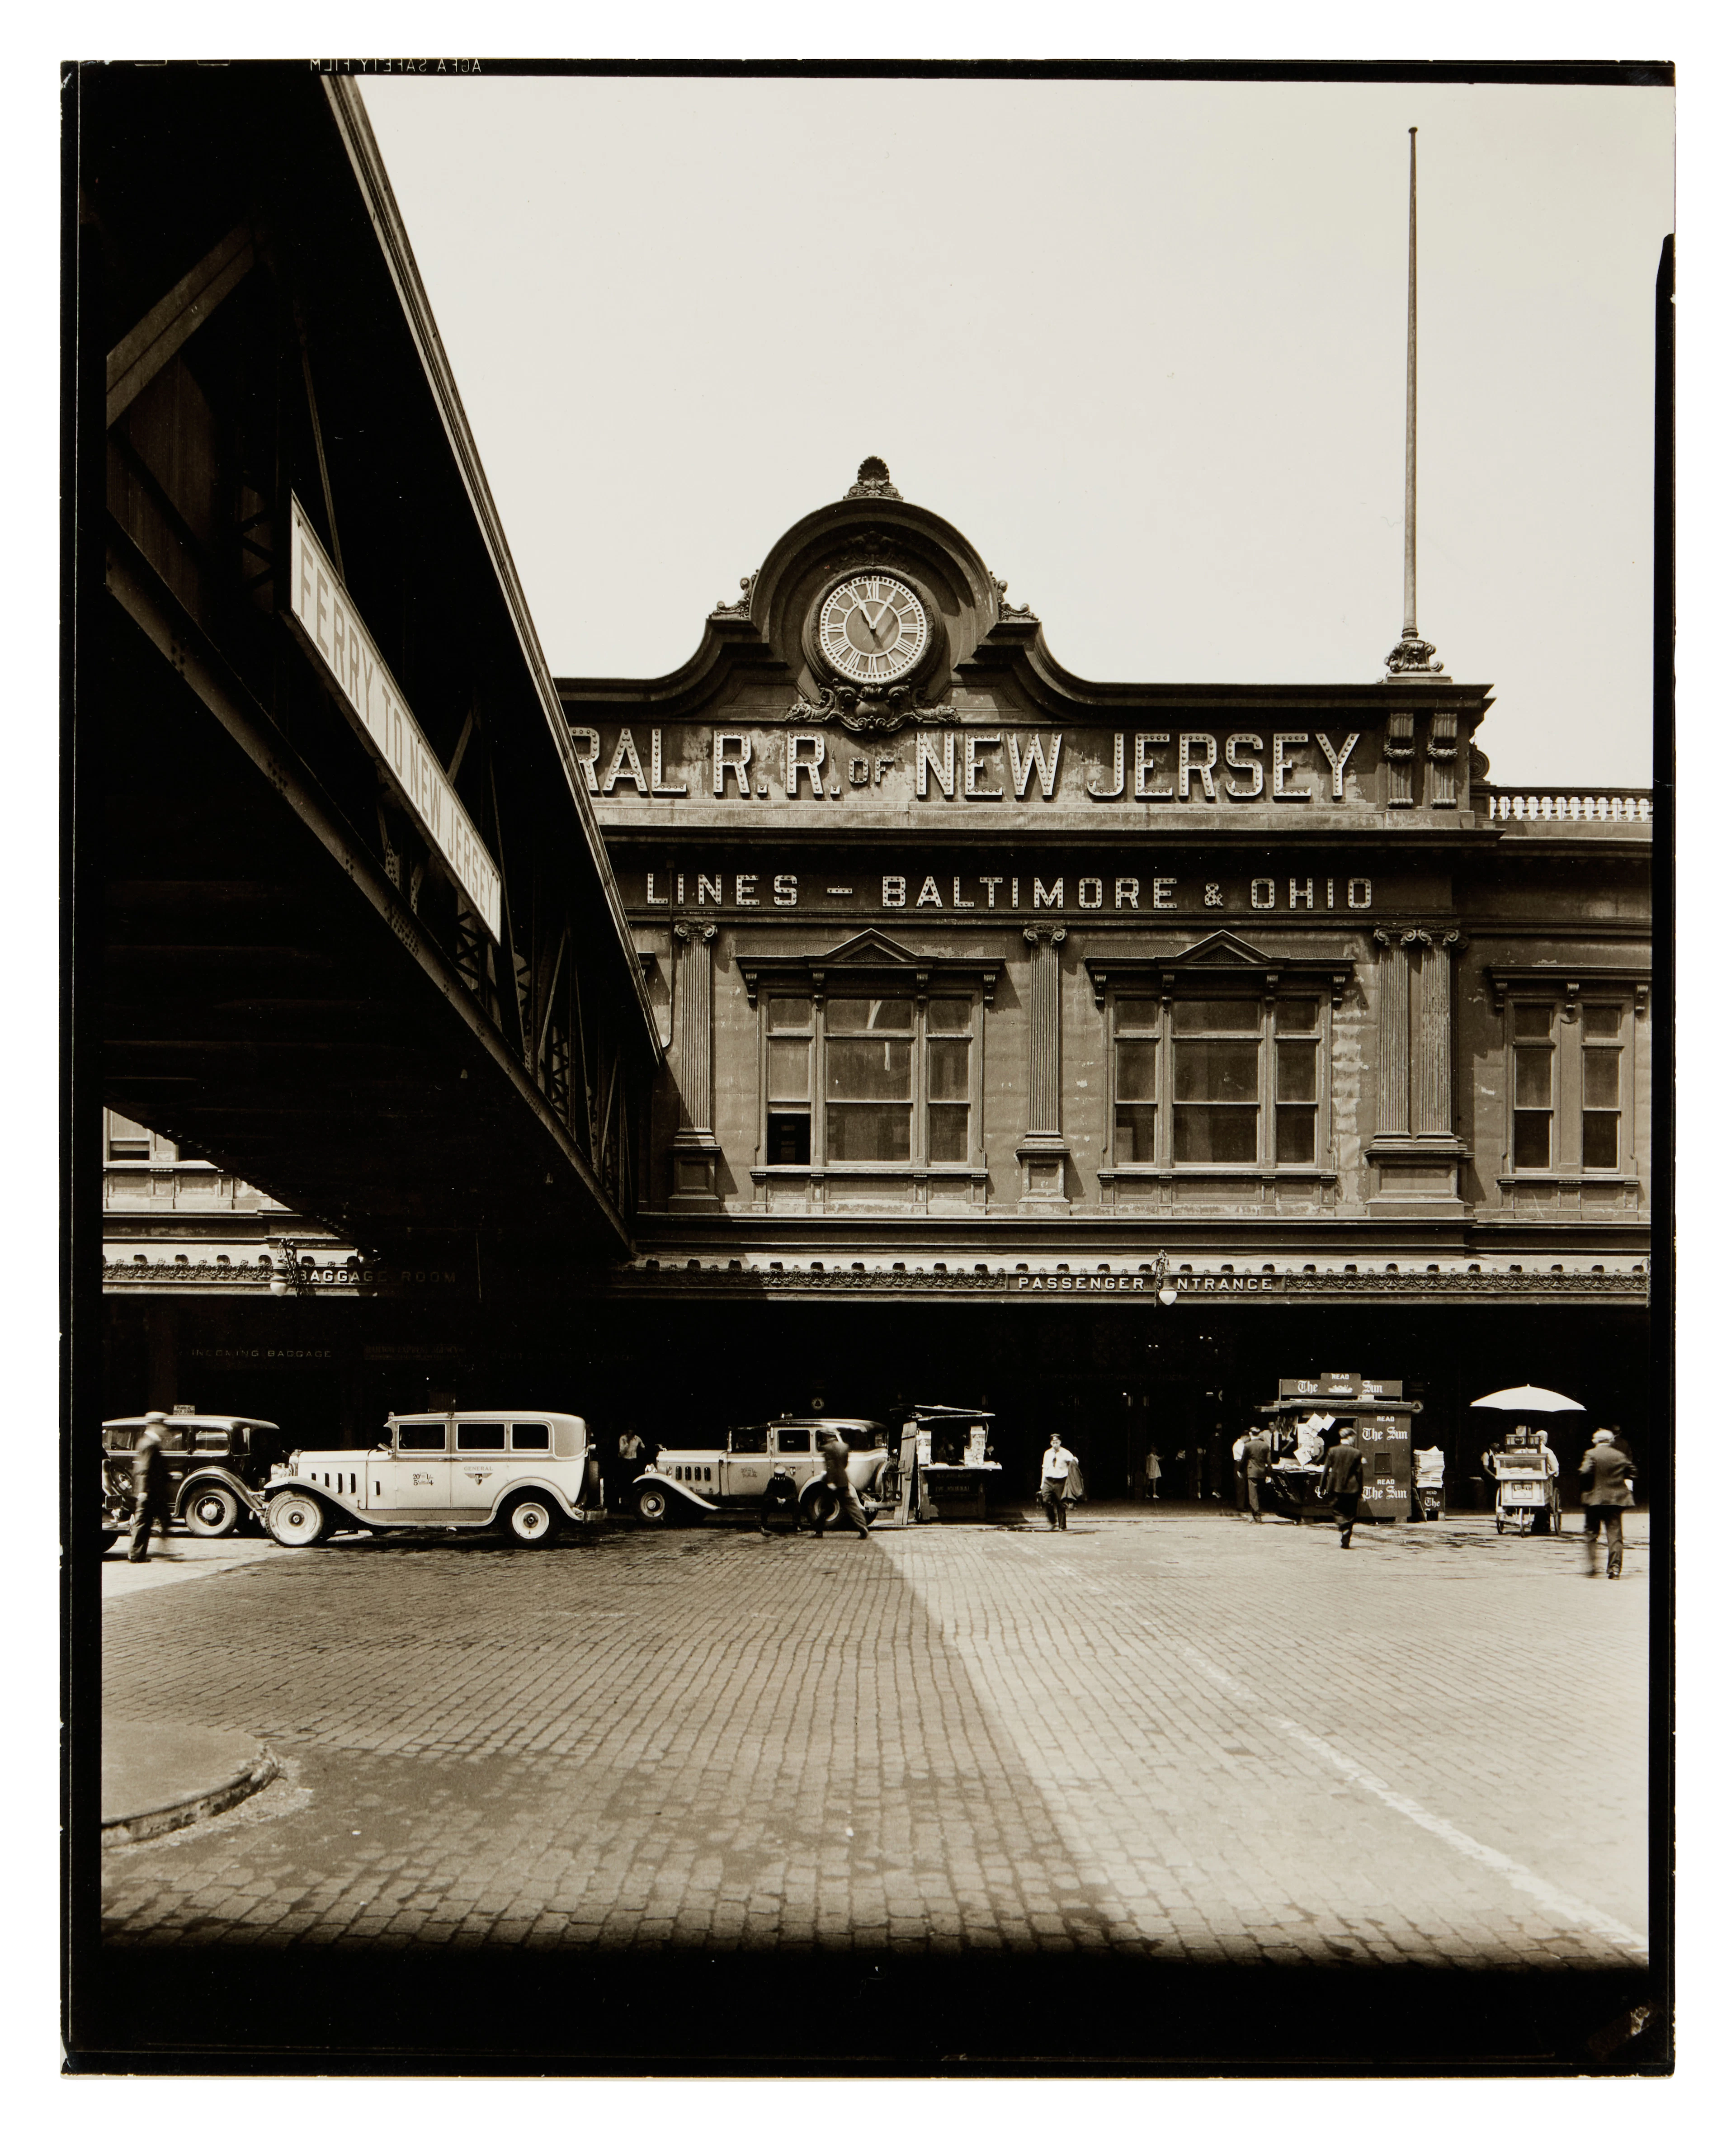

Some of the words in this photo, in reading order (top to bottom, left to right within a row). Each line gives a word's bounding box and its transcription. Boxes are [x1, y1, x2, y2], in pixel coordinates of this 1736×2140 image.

[300, 537, 373, 725] FERRY
[382, 683, 403, 776] TO
[410, 734, 442, 840] NEW
[448, 805, 493, 921] JERSEY
[848, 756, 894, 784] OF
[917, 731, 1063, 797] NEW
[1086, 733, 1360, 797] JERSEY
[647, 873, 797, 906] LINES
[882, 876, 1177, 909] BALTIMORE
[1204, 883, 1224, 907] &
[1251, 878, 1372, 909] OHIO
[401, 1271, 455, 1283] ROOM
[1018, 1277, 1144, 1290] PASSENGER
[1177, 1278, 1273, 1290] NTRANCE
[1297, 1380, 1319, 1394] The
[1362, 1380, 1383, 1394] Sun
[1362, 1427, 1383, 1441] The
[1386, 1426, 1408, 1441] Sun
[1362, 1486, 1384, 1500] The
[1385, 1485, 1407, 1499] Sun
[1424, 1497, 1441, 1508] The
